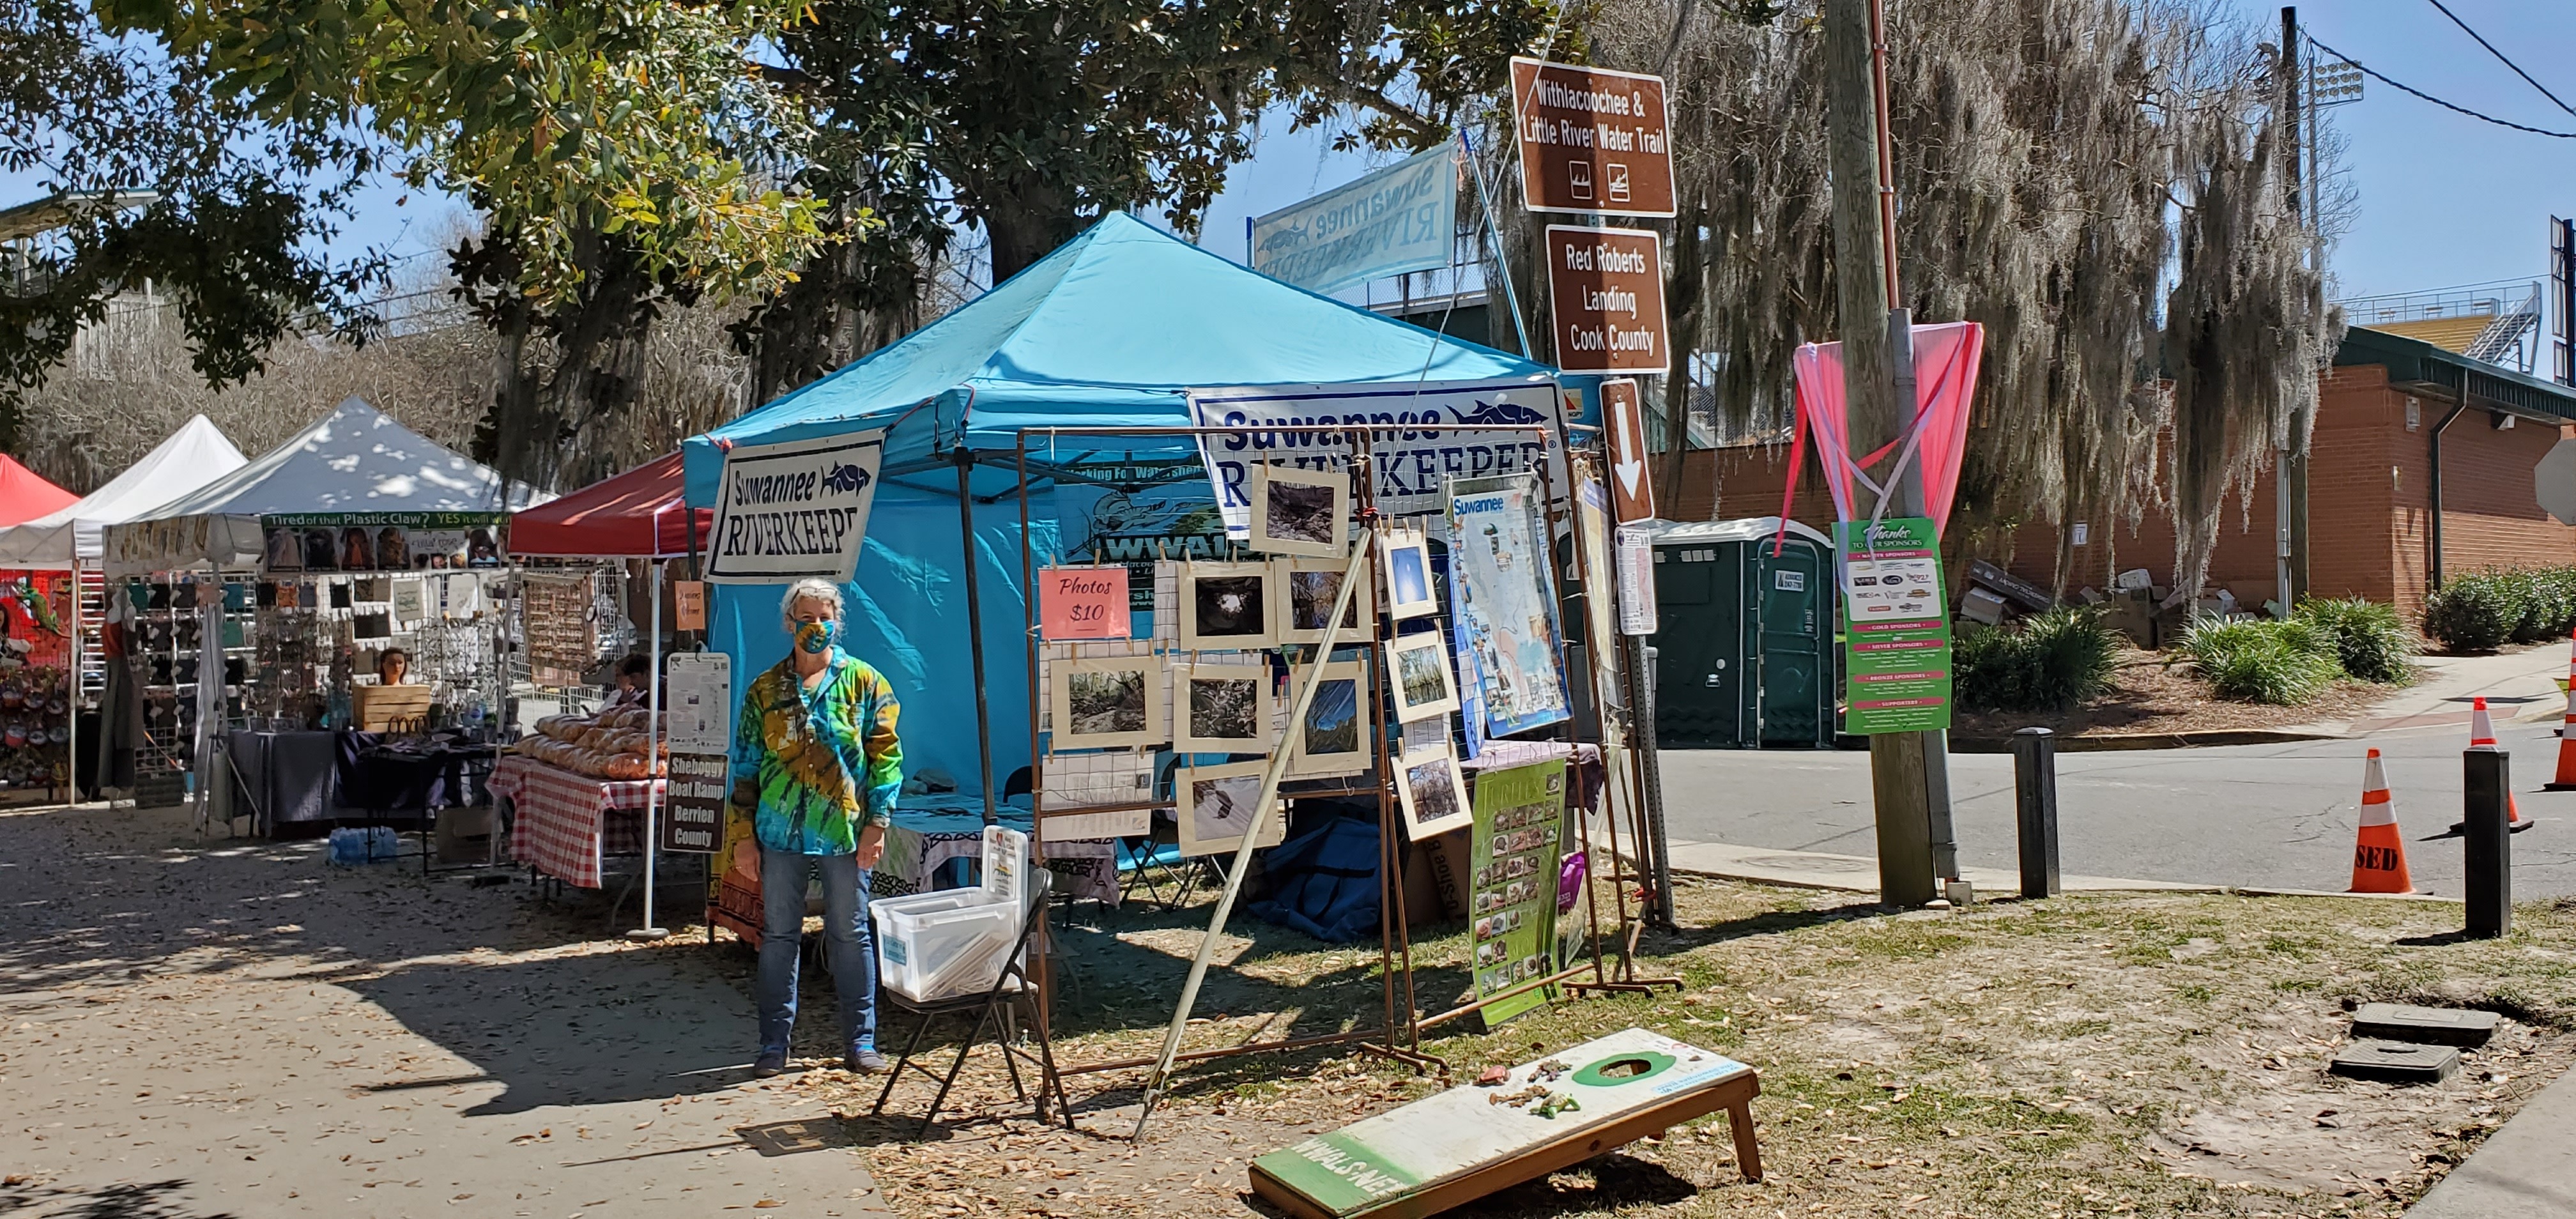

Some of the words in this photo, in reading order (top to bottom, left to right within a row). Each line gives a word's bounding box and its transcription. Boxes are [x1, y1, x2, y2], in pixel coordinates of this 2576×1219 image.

[1536, 77, 1629, 117] Withlacoochee
[1632, 90, 1646, 118] &
[1522, 114, 1558, 145] Little
[1560, 119, 1595, 148] River
[1597, 122, 1633, 151] Water
[1636, 126, 1665, 154] Trail
[1565, 243, 1592, 271] Red
[1597, 244, 1646, 274] Roberts
[1582, 284, 1637, 320] Landing
[1570, 323, 1606, 351] Cook
[1608, 323, 1655, 357] County
[1223, 410, 1441, 451] Suwannee
[735, 470, 816, 507] Suwannee
[1453, 497, 1504, 516] Suwannee
[269, 514, 305, 525] Tired
[306, 516, 317, 525] of
[319, 516, 341, 525] that
[343, 513, 387, 525] Plastic
[389, 512, 430, 528] Claw?
[437, 512, 461, 524] YES
[1883, 539, 1922, 548] SPONSORS
[1059, 576, 1113, 595] Photos
[1070, 603, 1105, 622] $10
[671, 756, 724, 778] Sheboggy
[668, 779, 693, 798] Boat
[694, 781, 724, 801] Ramp
[675, 805, 715, 824] Berrien
[674, 827, 713, 848] County
[2356, 845, 2398, 871] SED
